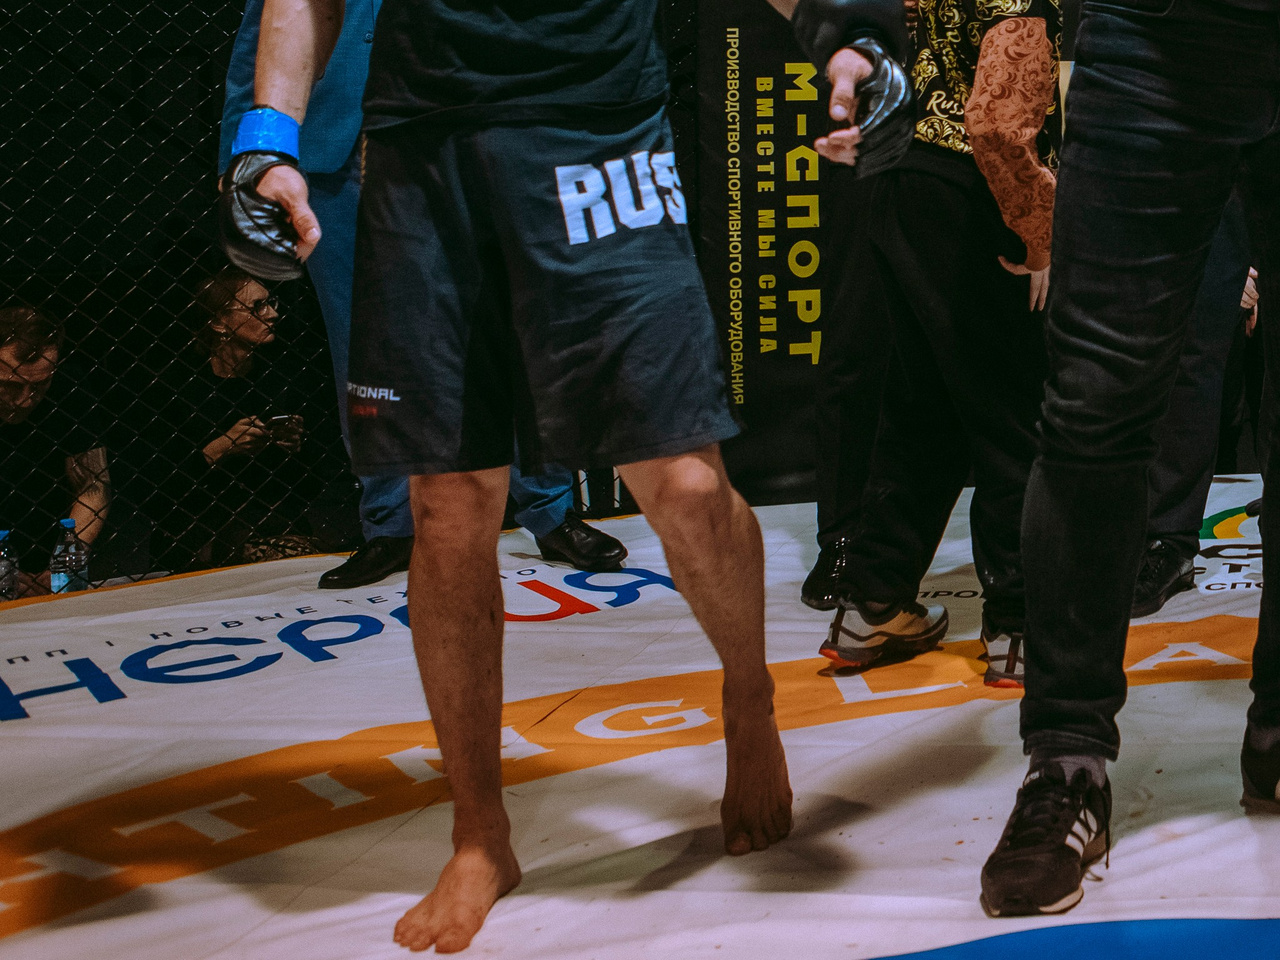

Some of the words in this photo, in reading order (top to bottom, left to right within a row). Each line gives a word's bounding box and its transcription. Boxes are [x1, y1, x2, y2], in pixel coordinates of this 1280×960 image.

[725, 26, 740, 154] ПРОИЗВОДСТВО
[756, 76, 776, 193] ВМЕСТЕ
[727, 157, 742, 274] СПОРТИВНОГО
[757, 208, 776, 257] МЫ
[784, 62, 822, 366] М-СПОРТ
[728, 277, 744, 405] ОБОРУДОВАНИЯ
[758, 272, 778, 355] СИЛА
